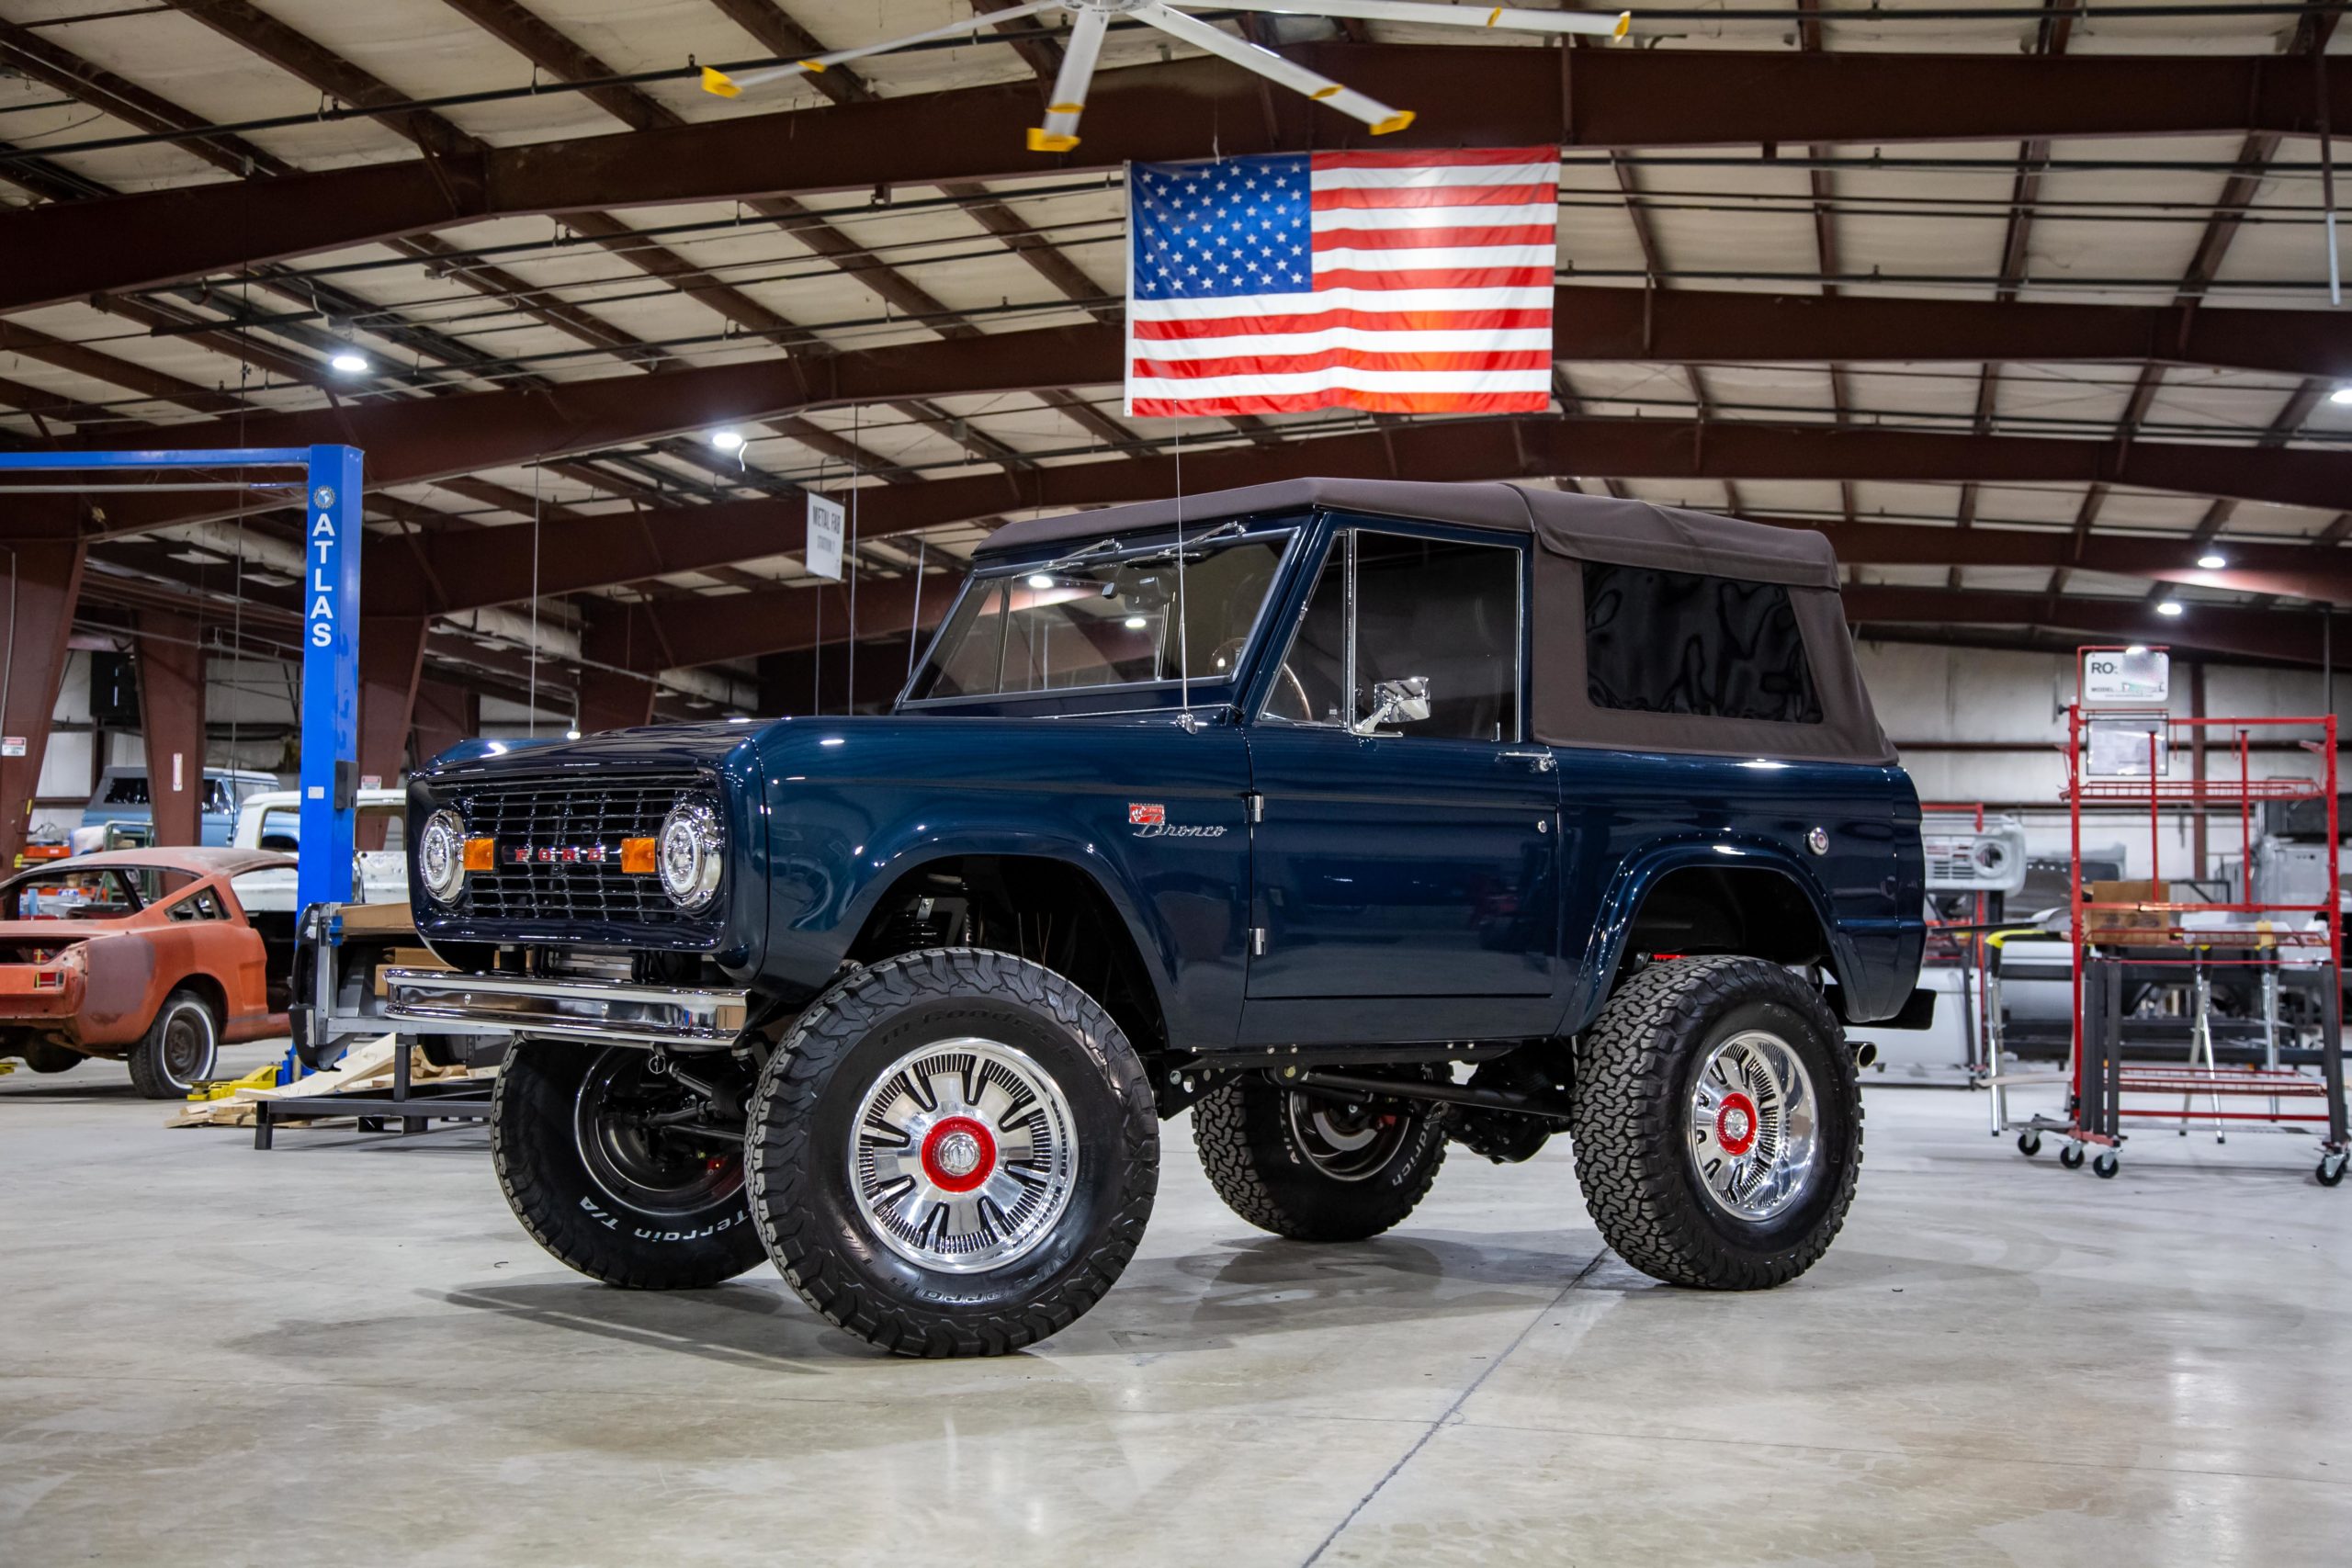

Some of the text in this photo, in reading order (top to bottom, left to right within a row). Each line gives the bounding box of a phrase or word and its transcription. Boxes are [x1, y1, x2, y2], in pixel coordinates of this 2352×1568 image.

[311, 513, 335, 648] ATLAS
[1133, 813, 1227, 838] Bronco
[514, 846, 606, 863] FORD
[580, 1195, 619, 1231] T/A
